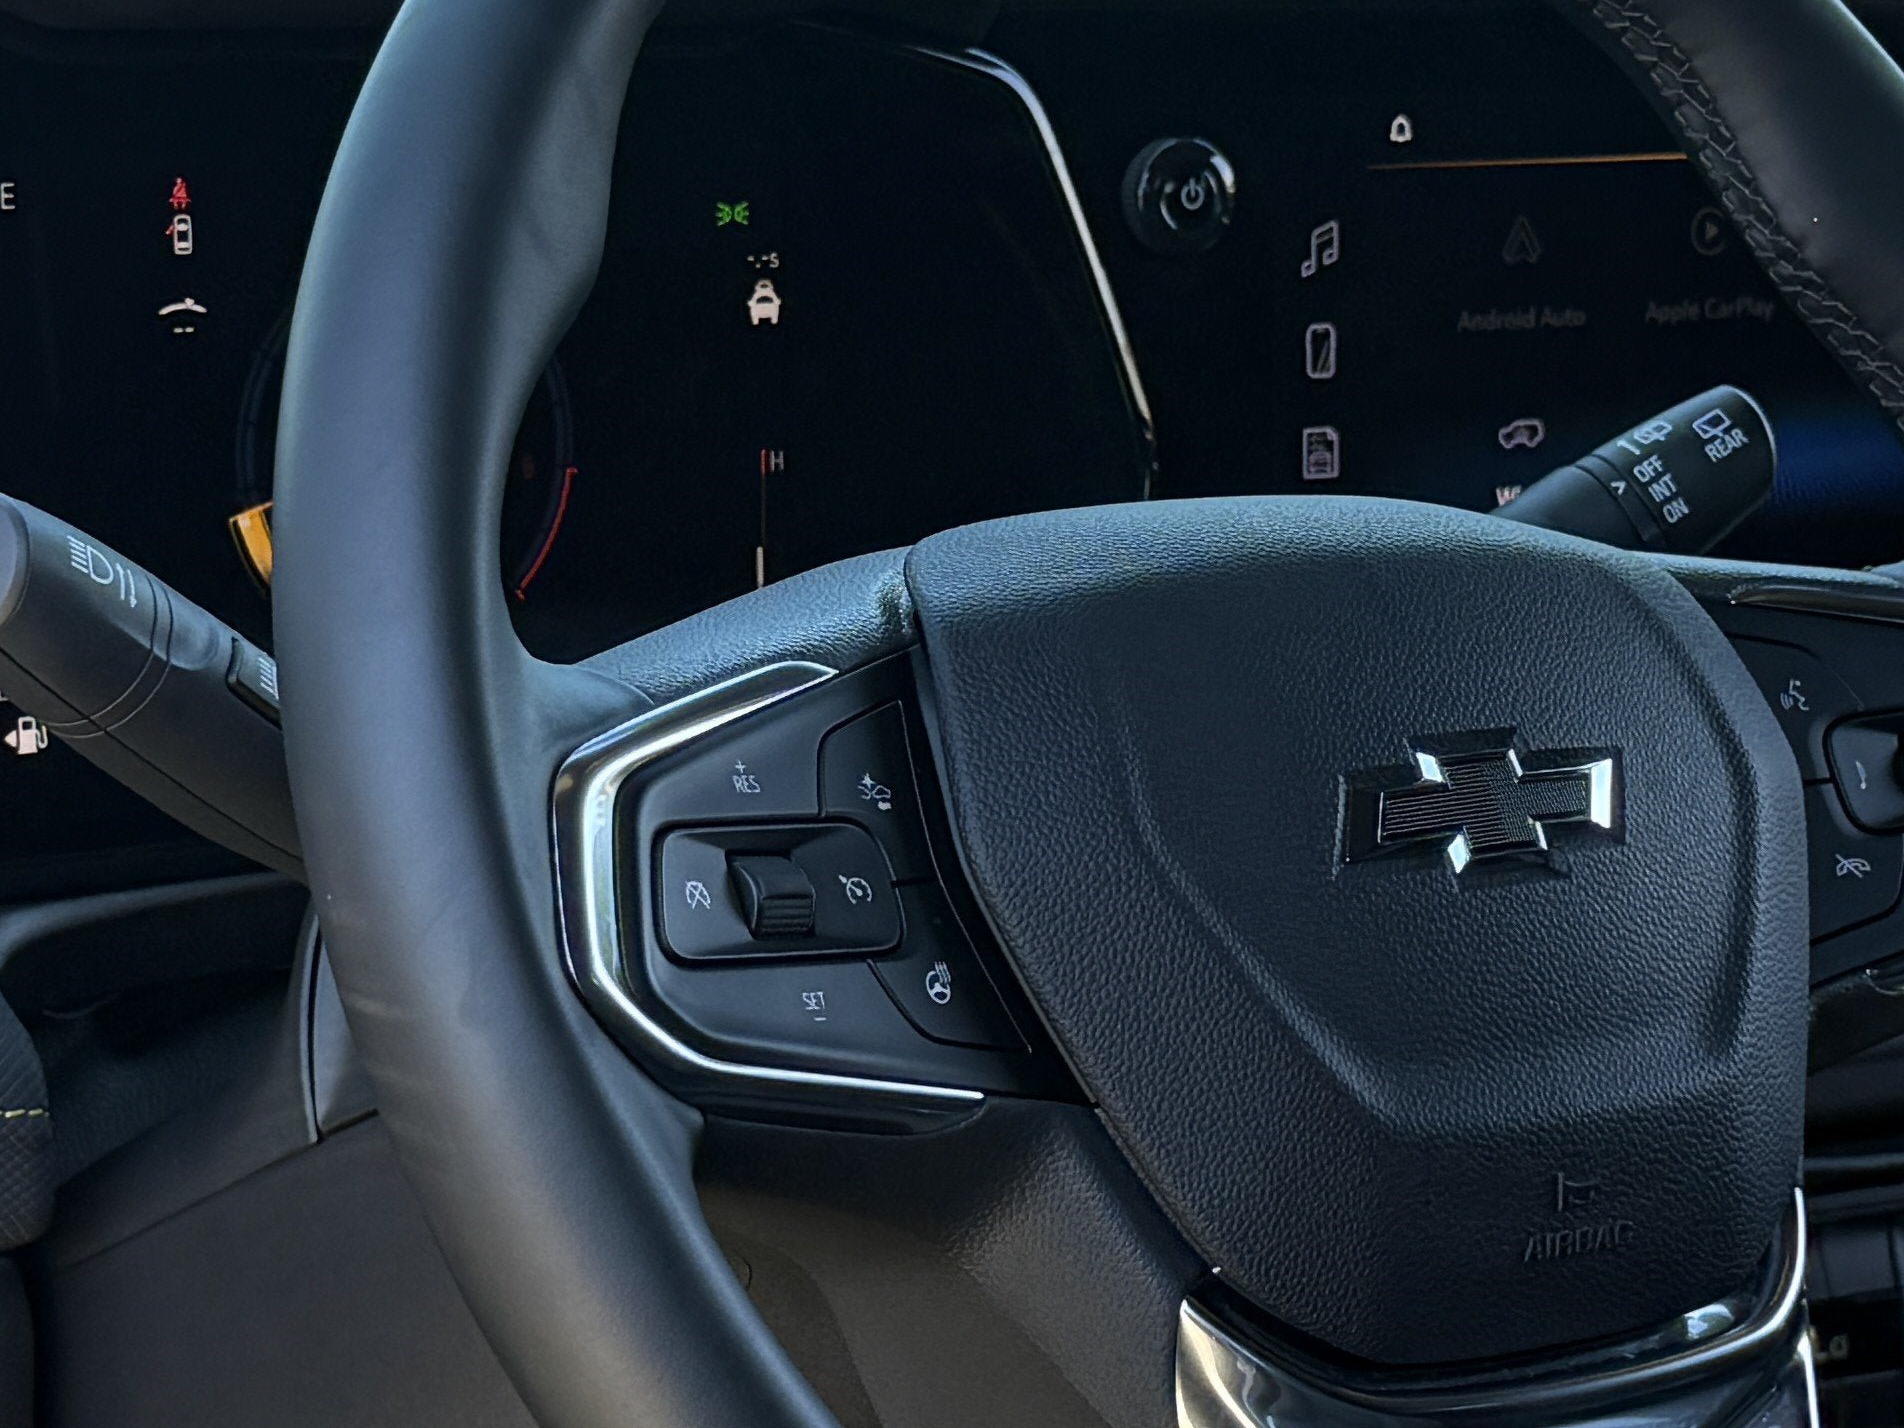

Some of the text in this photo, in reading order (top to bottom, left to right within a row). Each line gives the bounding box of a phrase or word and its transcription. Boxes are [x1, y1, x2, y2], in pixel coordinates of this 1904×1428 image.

[1457, 305, 1587, 331] Android Auto
[1645, 295, 1775, 325] Apple CarPlay
[1704, 427, 1749, 463] REAR
[1633, 454, 1664, 483] OFF
[1648, 473, 1677, 503] INT
[1662, 497, 1690, 523] ON
[733, 774, 761, 793] RES
[802, 991, 825, 1011] SET
